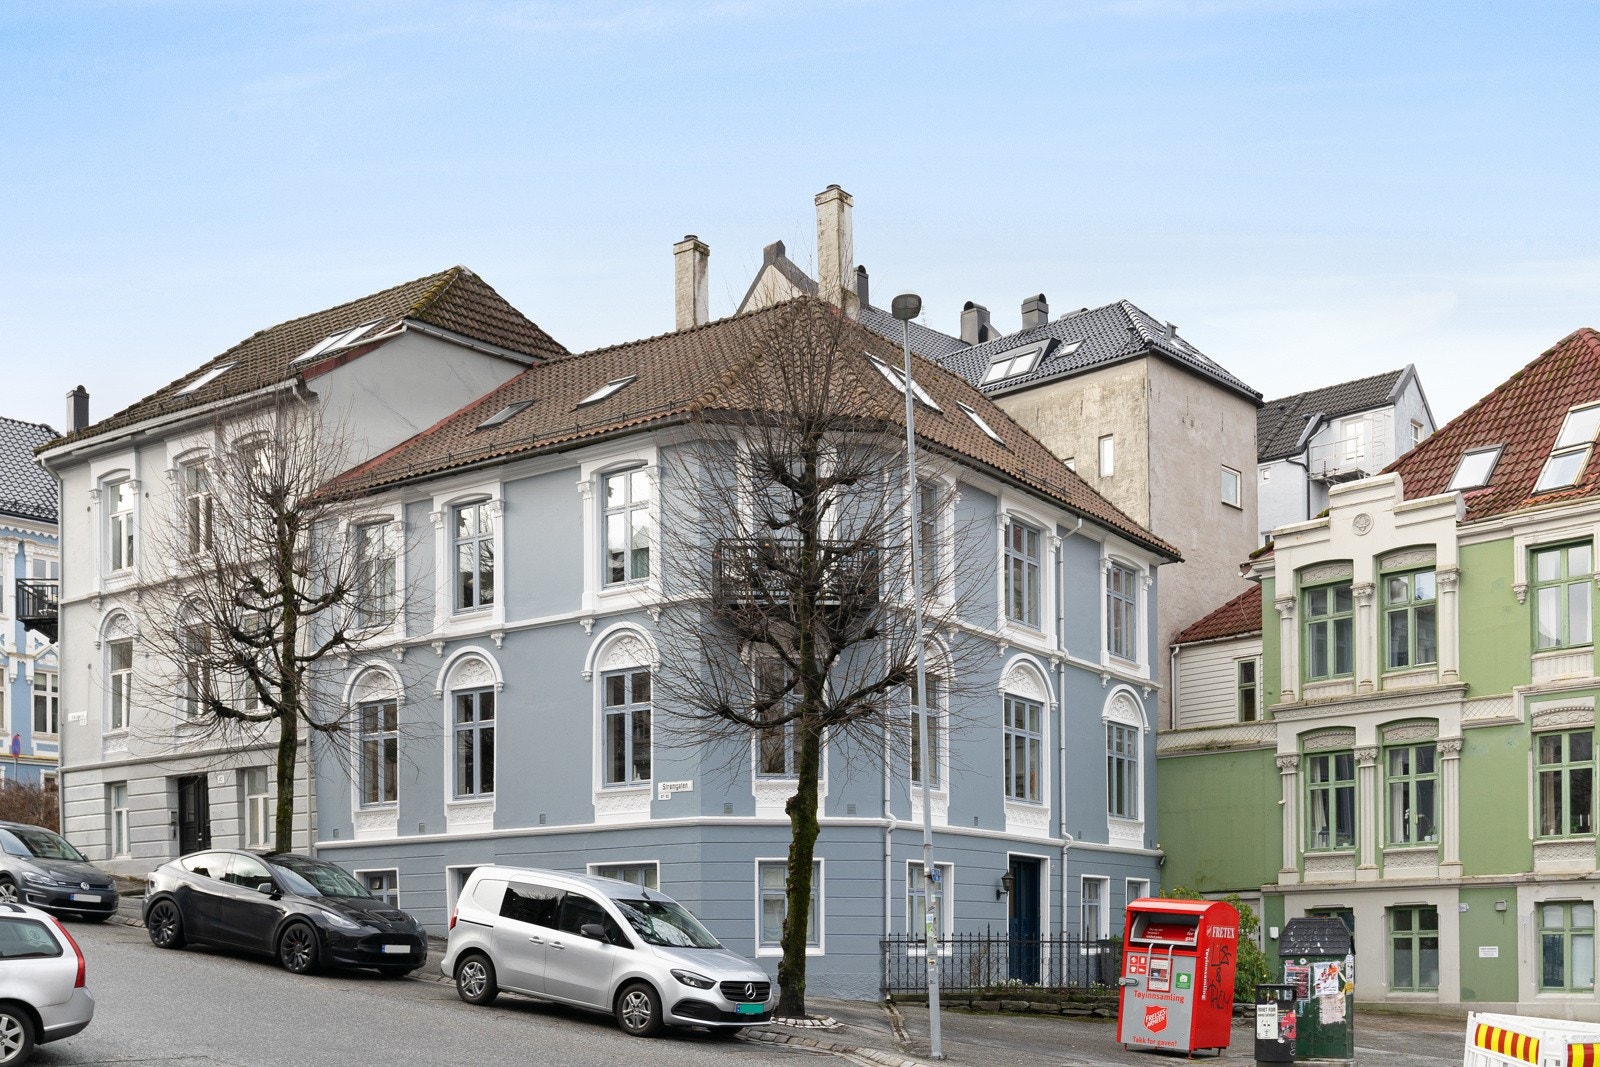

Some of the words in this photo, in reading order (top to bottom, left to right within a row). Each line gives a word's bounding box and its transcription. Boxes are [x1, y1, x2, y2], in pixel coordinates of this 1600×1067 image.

[1212, 926, 1235, 939] FRETEX
[1201, 947, 1210, 1001] Tøyinnsamling
[1133, 990, 1185, 1005] Tøyinnsamling
[1132, 1036, 1146, 1044] Takk
[1147, 1037, 1156, 1045] for
